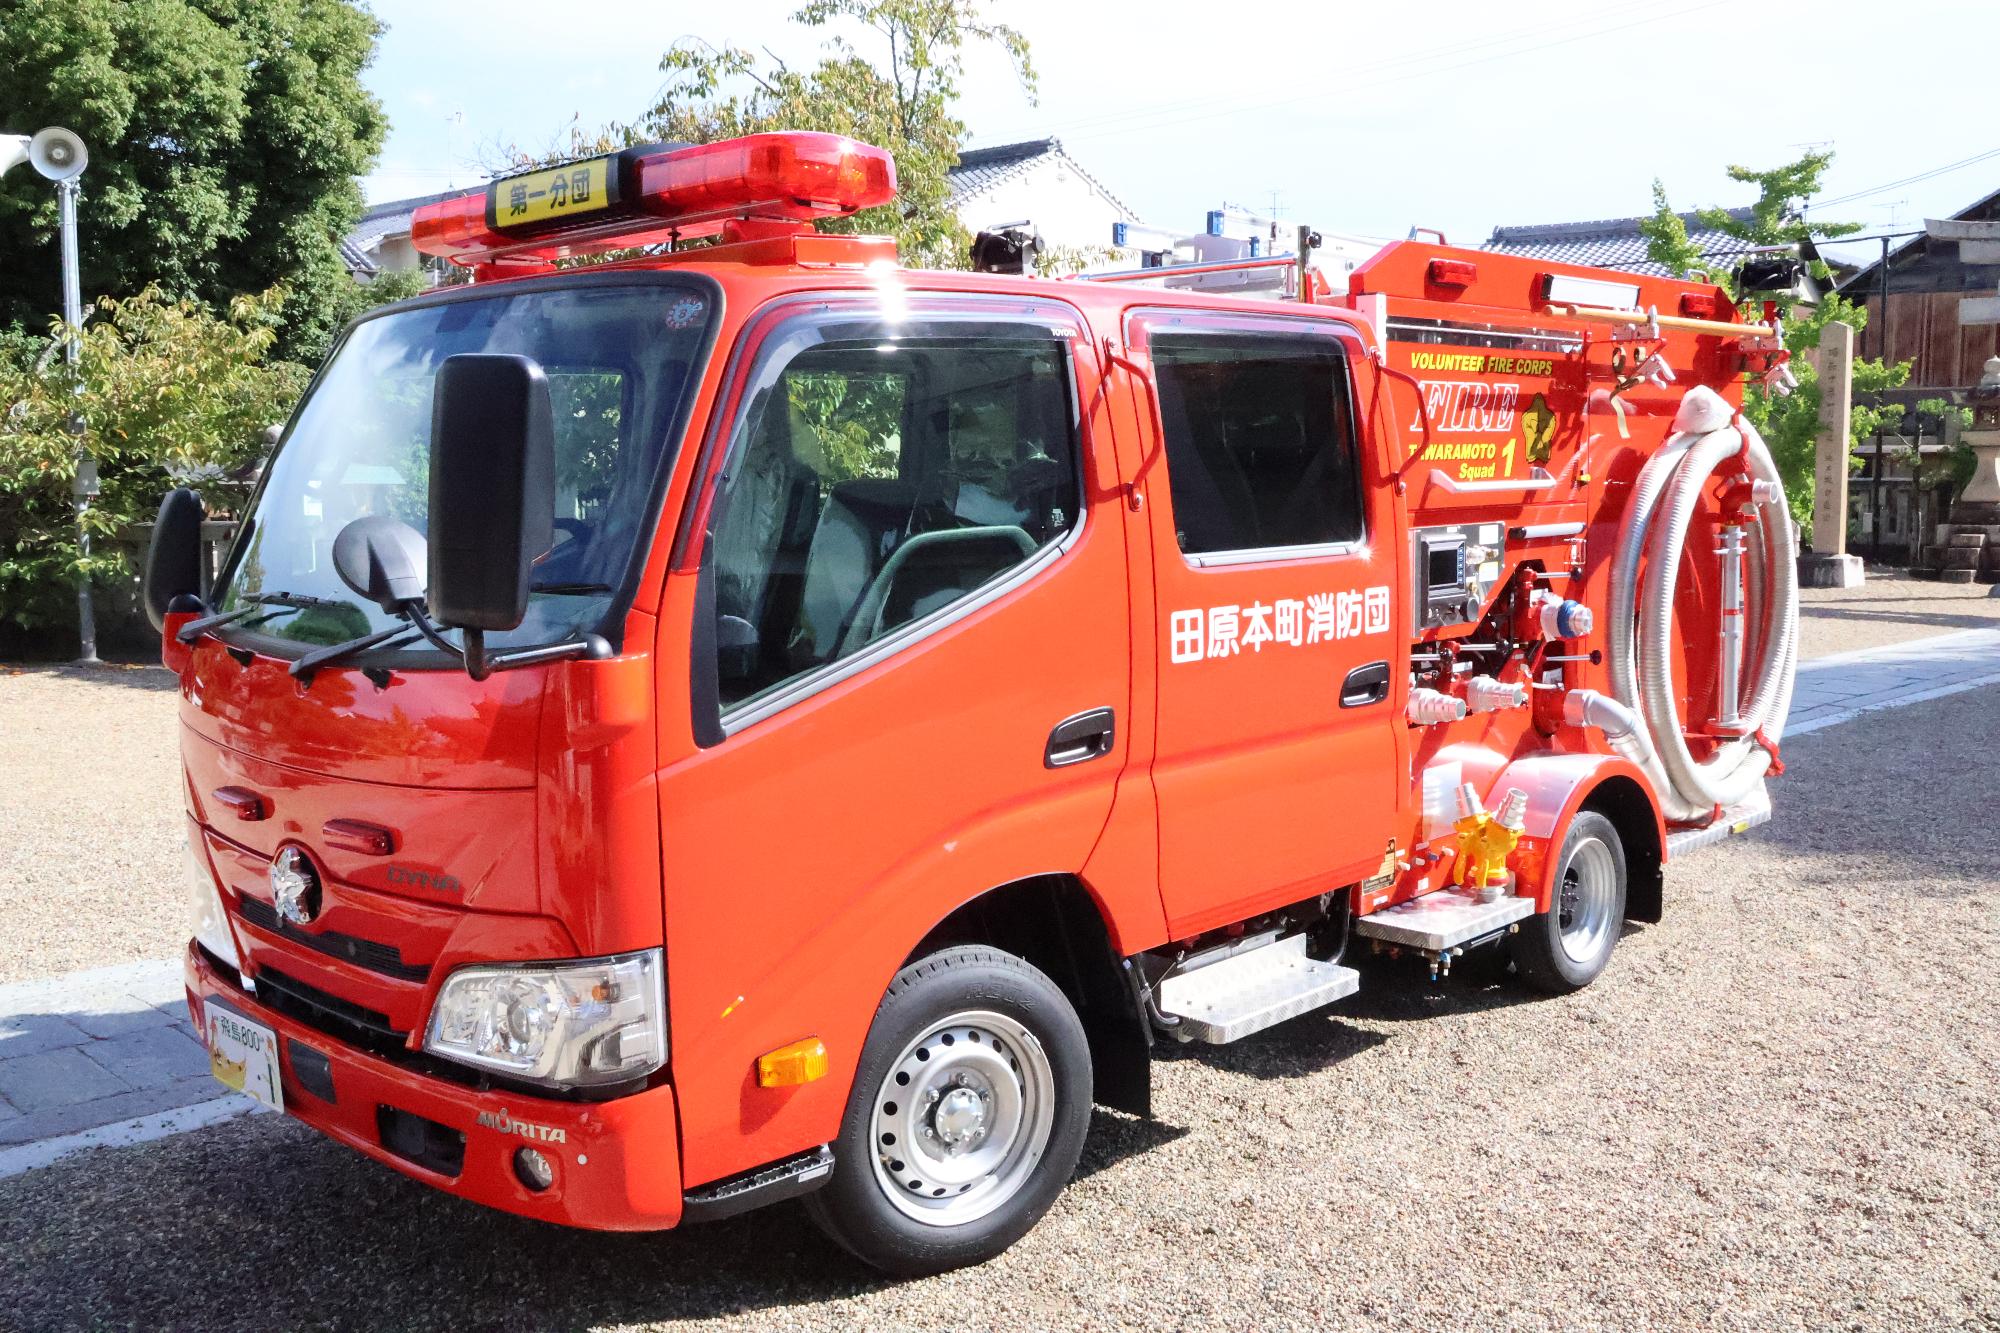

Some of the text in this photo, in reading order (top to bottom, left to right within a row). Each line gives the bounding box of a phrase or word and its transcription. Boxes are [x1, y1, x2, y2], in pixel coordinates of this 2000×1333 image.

[510, 168, 590, 216] 第一分団
[1051, 328, 1077, 337] TOYOTA
[1411, 352, 1553, 375] VOLUNTEER FIRE CORPS
[1409, 381, 1519, 432] FIRE
[1408, 443, 1496, 461] TWARAMOTO
[1459, 438, 1517, 482] Squad 1
[1171, 586, 1389, 664] 田原本町消防団
[476, 1107, 566, 1144] MORITA
